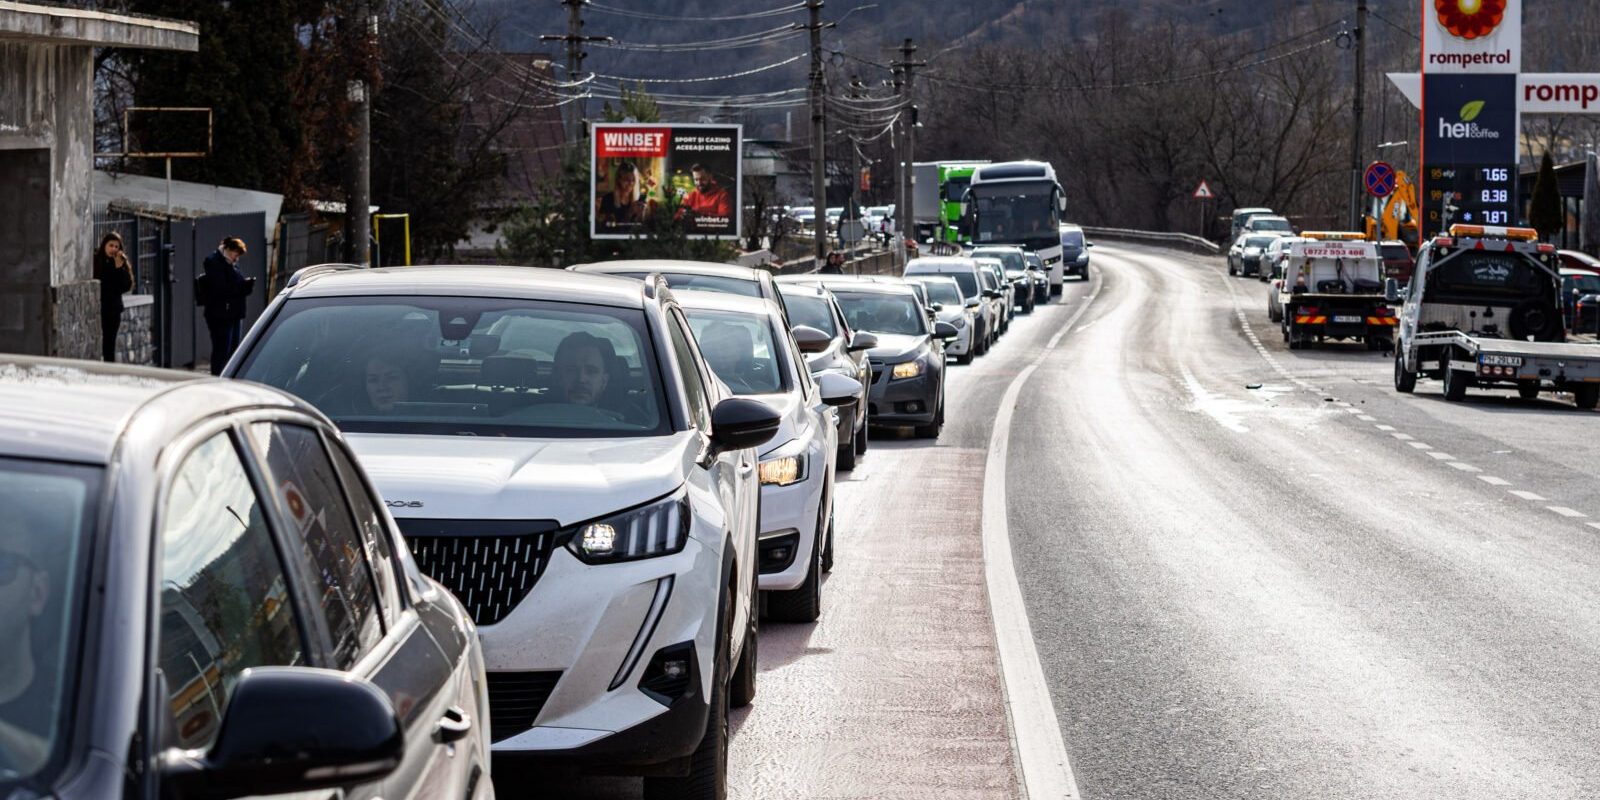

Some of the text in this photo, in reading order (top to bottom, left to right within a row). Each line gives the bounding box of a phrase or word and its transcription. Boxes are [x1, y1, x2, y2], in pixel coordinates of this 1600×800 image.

[1429, 49, 1511, 68] rompetrol
[1524, 84, 1598, 109] romp
[603, 132, 664, 147] WINBET
[1471, 128, 1499, 138] coffee
[1482, 168, 1508, 181] 7.66
[1481, 189, 1508, 203] 8.38
[1482, 210, 1508, 224] 7.87
